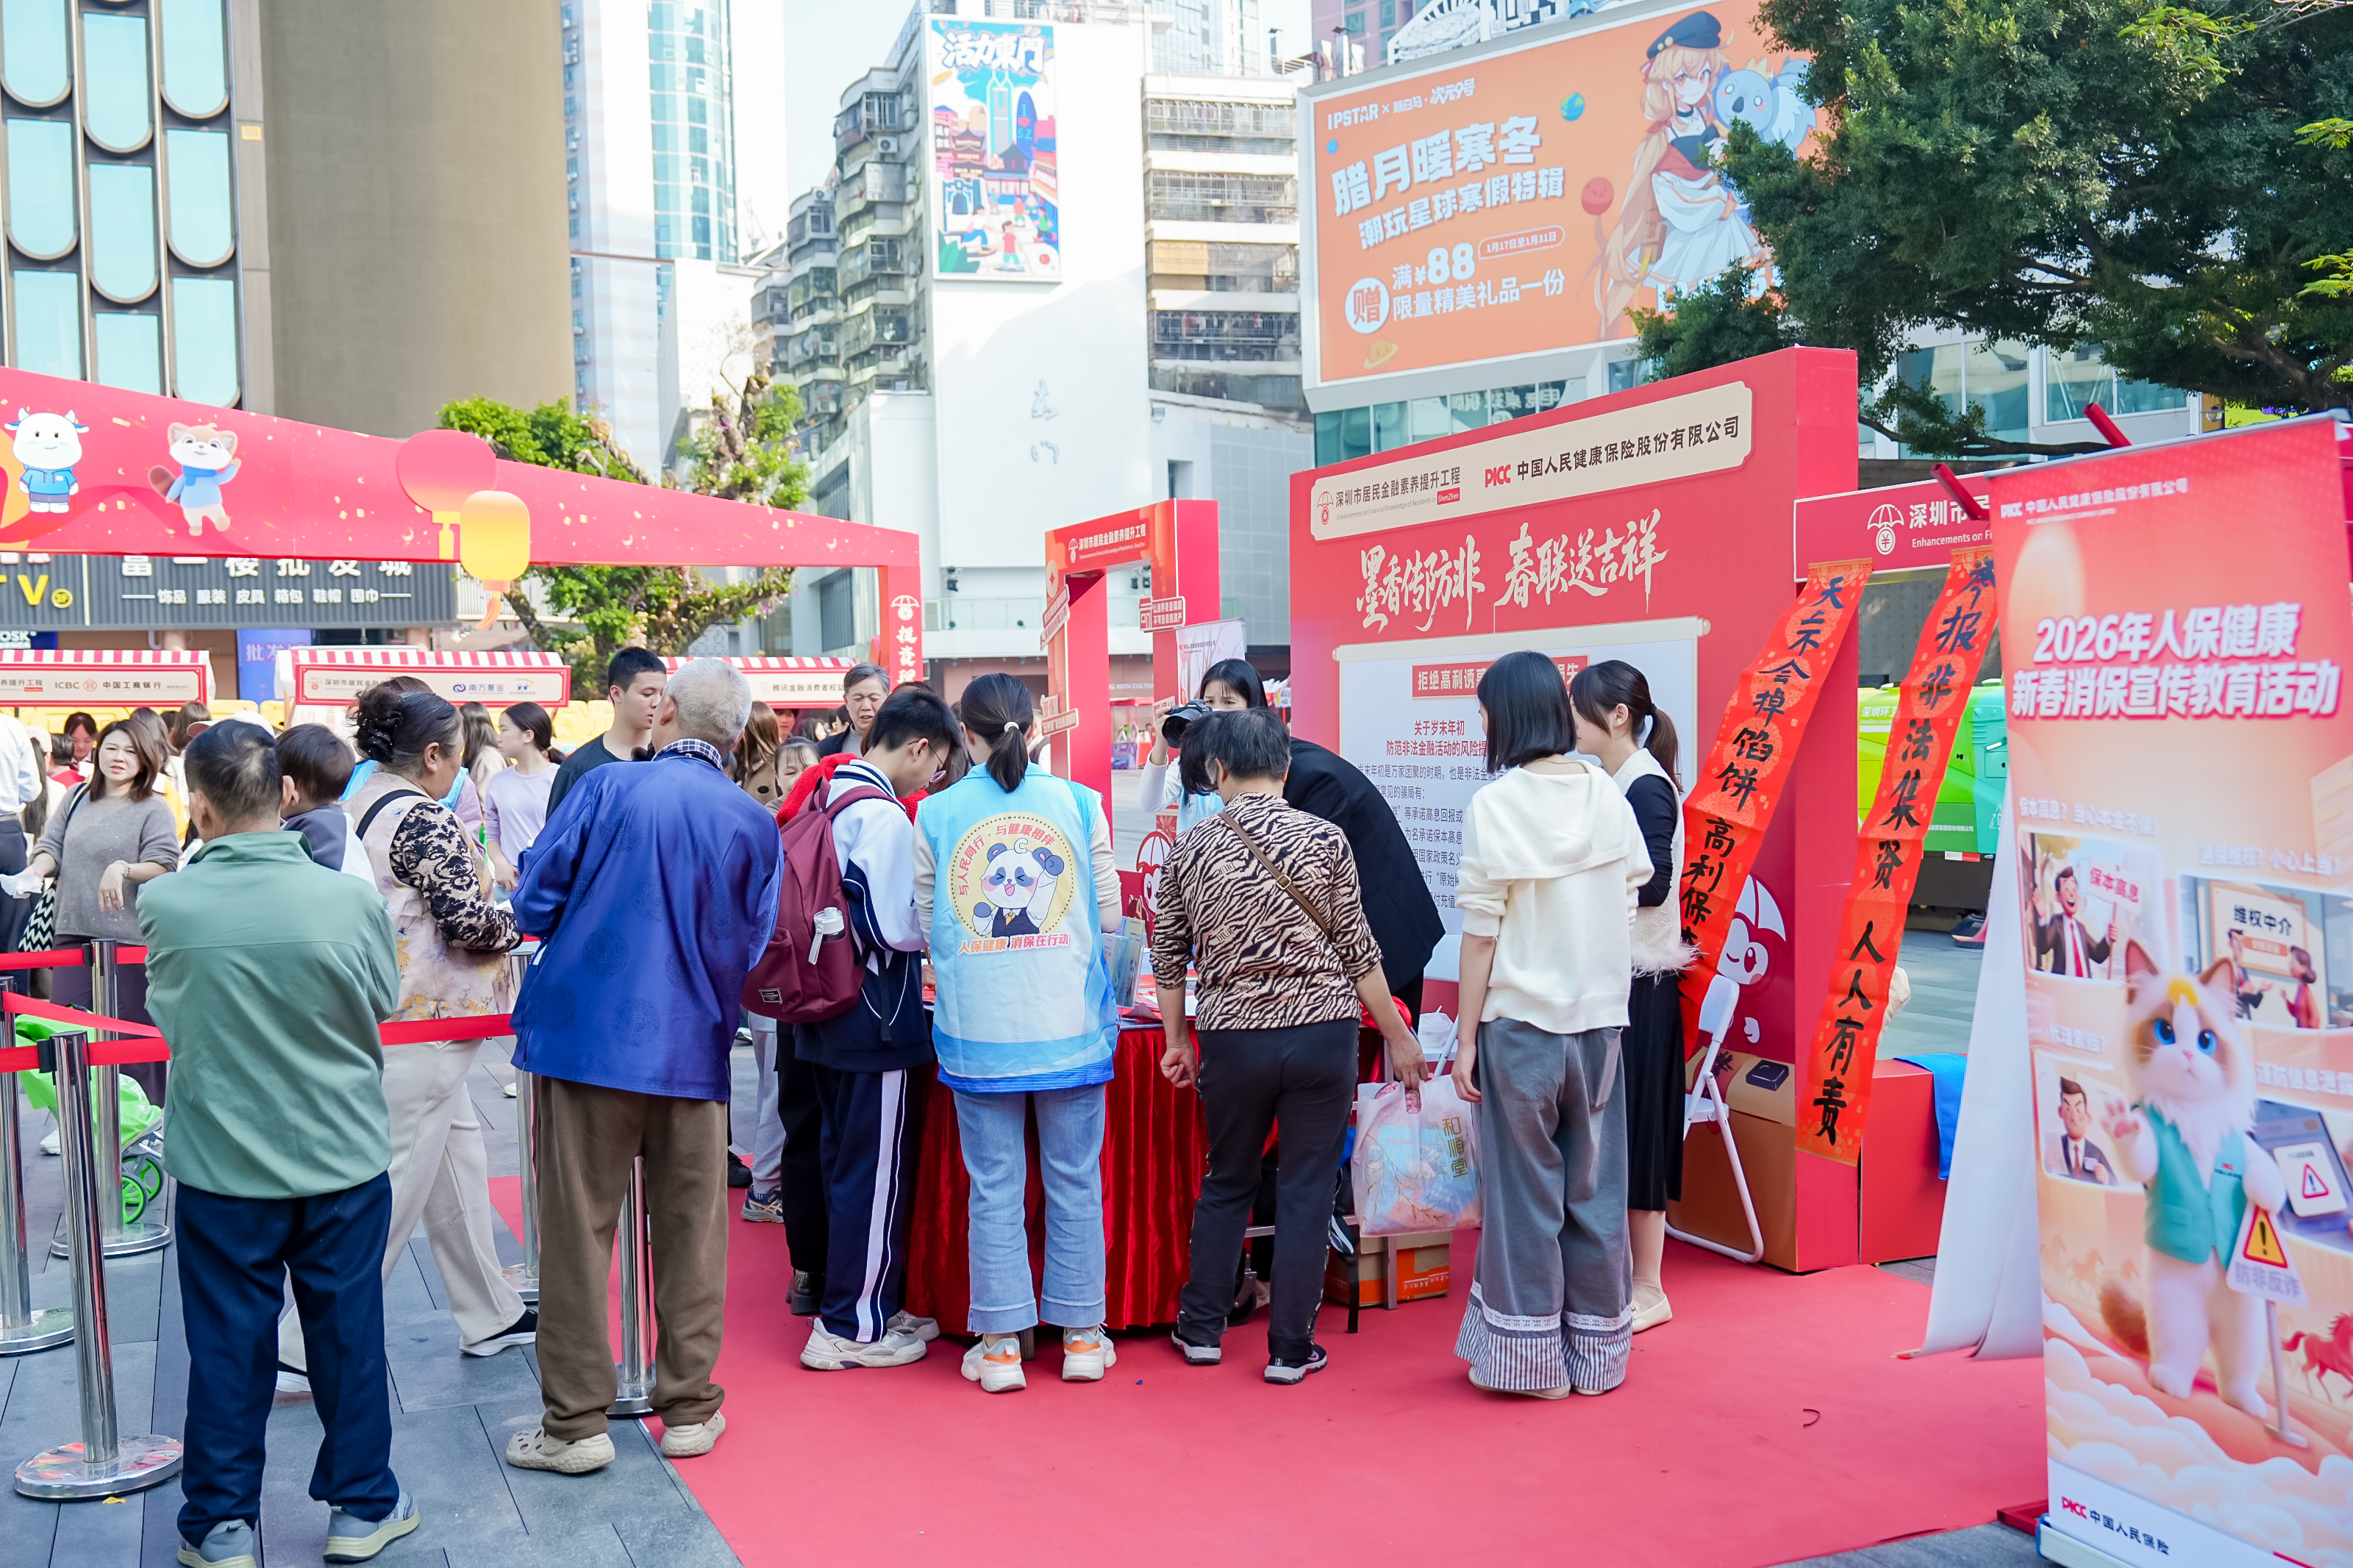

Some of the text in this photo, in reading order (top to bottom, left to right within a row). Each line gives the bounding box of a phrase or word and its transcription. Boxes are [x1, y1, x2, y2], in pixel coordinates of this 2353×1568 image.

[943, 31, 1044, 71] 活力東門
[1327, 103, 1379, 130] IPSTAR
[1332, 116, 1540, 217] 腊月暖寒冬
[1359, 167, 1565, 249] 潮玩星球寒假特辑
[1486, 232, 1557, 254] 1月17日至1月31日
[1352, 284, 1382, 324] 赠
[1393, 268, 1565, 321] 限量精美礼品一份
[1485, 415, 1739, 487] PICC 中国人民健康保险股份有限公司
[1335, 466, 1460, 508] 深圳市居民金融素养提升工程
[1336, 511, 1363, 520] Enhancements
[1368, 506, 1385, 515] Financial
[1385, 504, 1407, 512] Knowledge
[1413, 498, 1432, 506] Residents
[1438, 492, 1460, 503] ShenZhen
[2000, 502, 2023, 518] PICC
[1912, 532, 1971, 548] Enhancements
[1971, 533, 1983, 542] on
[1356, 508, 1669, 634] 墨香传防非 春联送吉祥
[157, 588, 379, 605] 饰品 服装 皮具 箱包 鞋帽 围巾
[2033, 601, 2301, 663] 2026年人保健康
[246, 642, 306, 662] 批发
[103, 681, 162, 690] 中国工商银行
[325, 679, 385, 687] 深圳市居民金融
[468, 683, 504, 692] 南方基金
[1715, 576, 1846, 812] 天上不会掉馅饼
[2012, 660, 2339, 717] 新春消保宣传教育活动
[1414, 720, 1465, 737] 关于岁末年初
[1404, 827, 1463, 845] 为名承诺保本高息
[959, 823, 1057, 896] 与人民同行 与健康相伴
[2090, 866, 2139, 903] 保本高息
[2232, 904, 2292, 937] 维权中介
[959, 934, 1068, 954] 人保健康 消保在行动
[1813, 920, 1886, 1146] 人人有责
[1442, 1117, 1468, 1178] 和順堂
[2235, 1260, 2302, 1297] 防非反诈
[2061, 1494, 2170, 1556] PICC 中国人民保险
